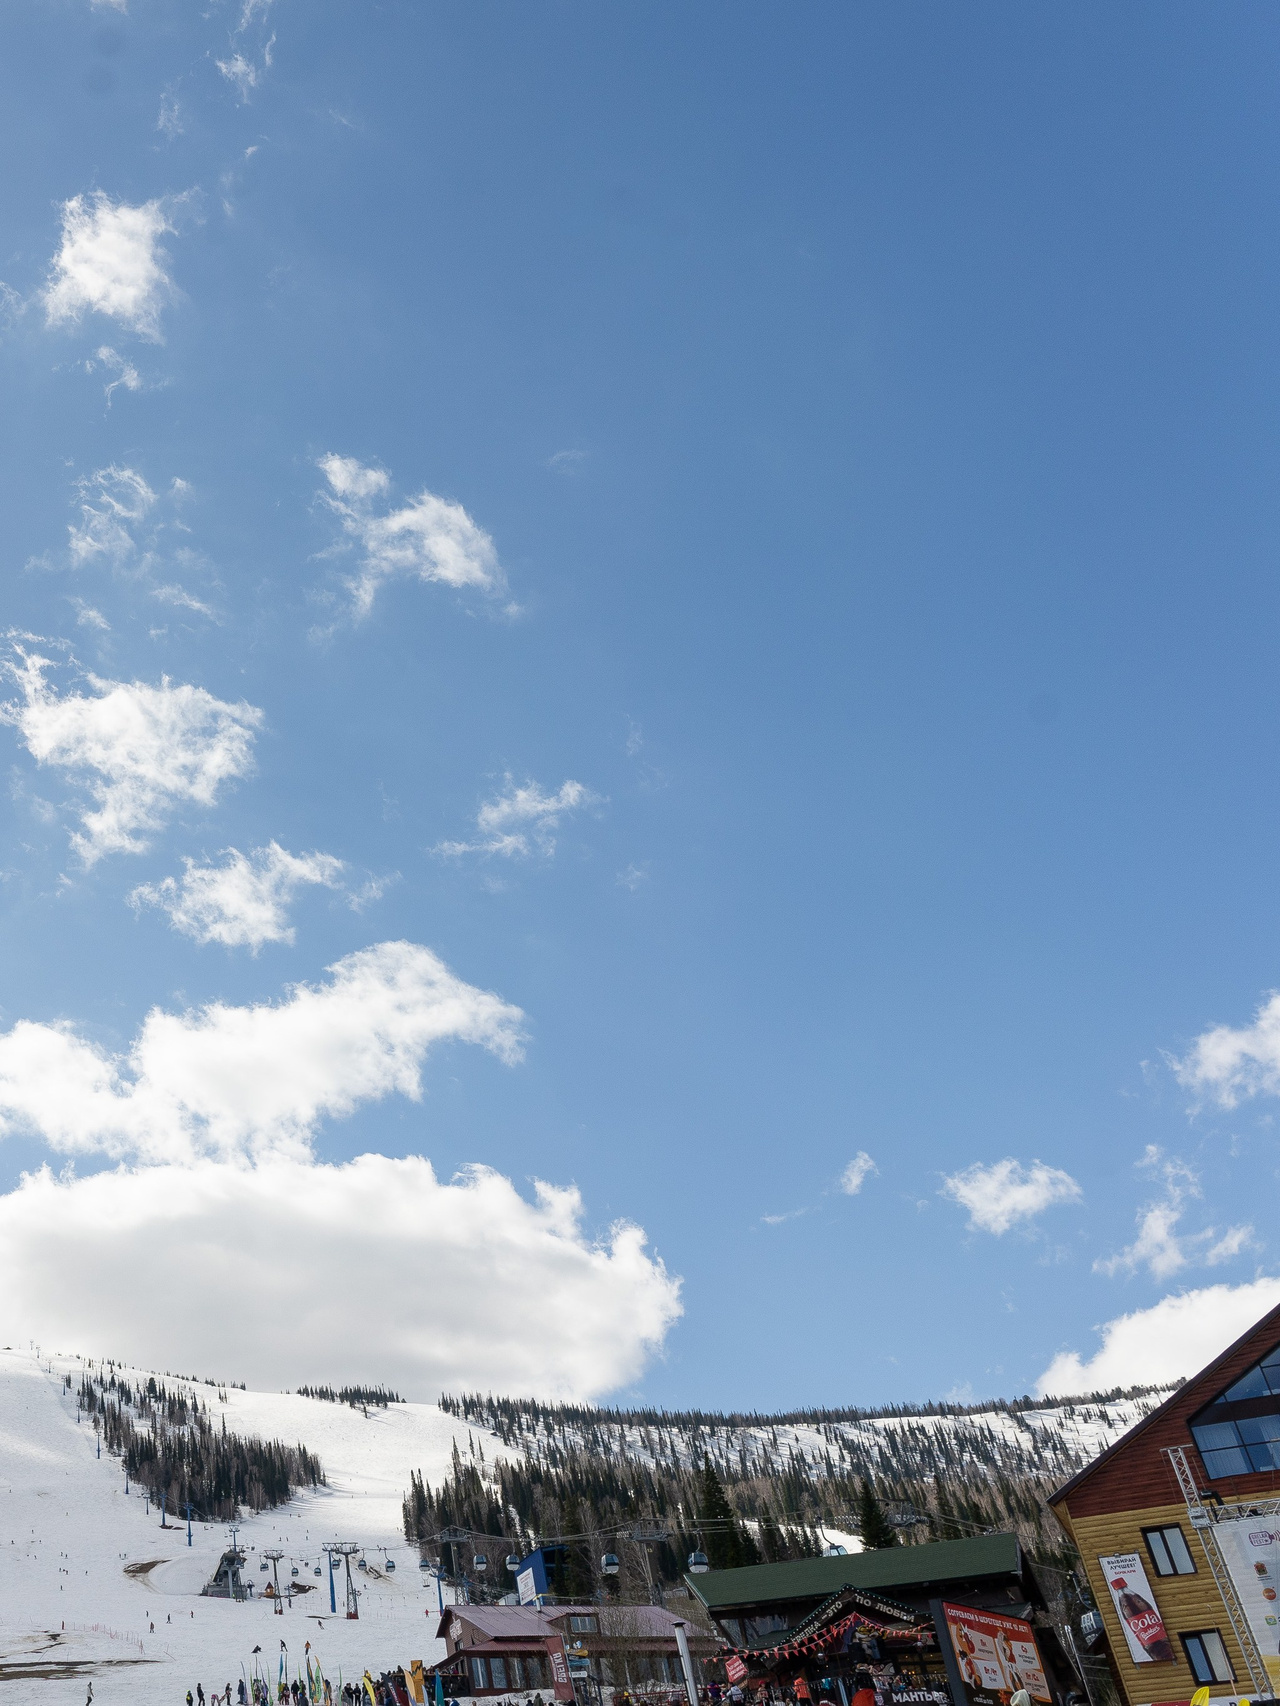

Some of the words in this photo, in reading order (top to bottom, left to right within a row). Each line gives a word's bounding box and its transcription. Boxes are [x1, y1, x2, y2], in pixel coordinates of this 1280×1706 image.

[1107, 1556, 1136, 1566] ВЫБИРАЙ
[855, 1594, 871, 1607] ПО
[1130, 1614, 1159, 1632] Cola
[792, 1621, 821, 1644] ГРЕЛКА
